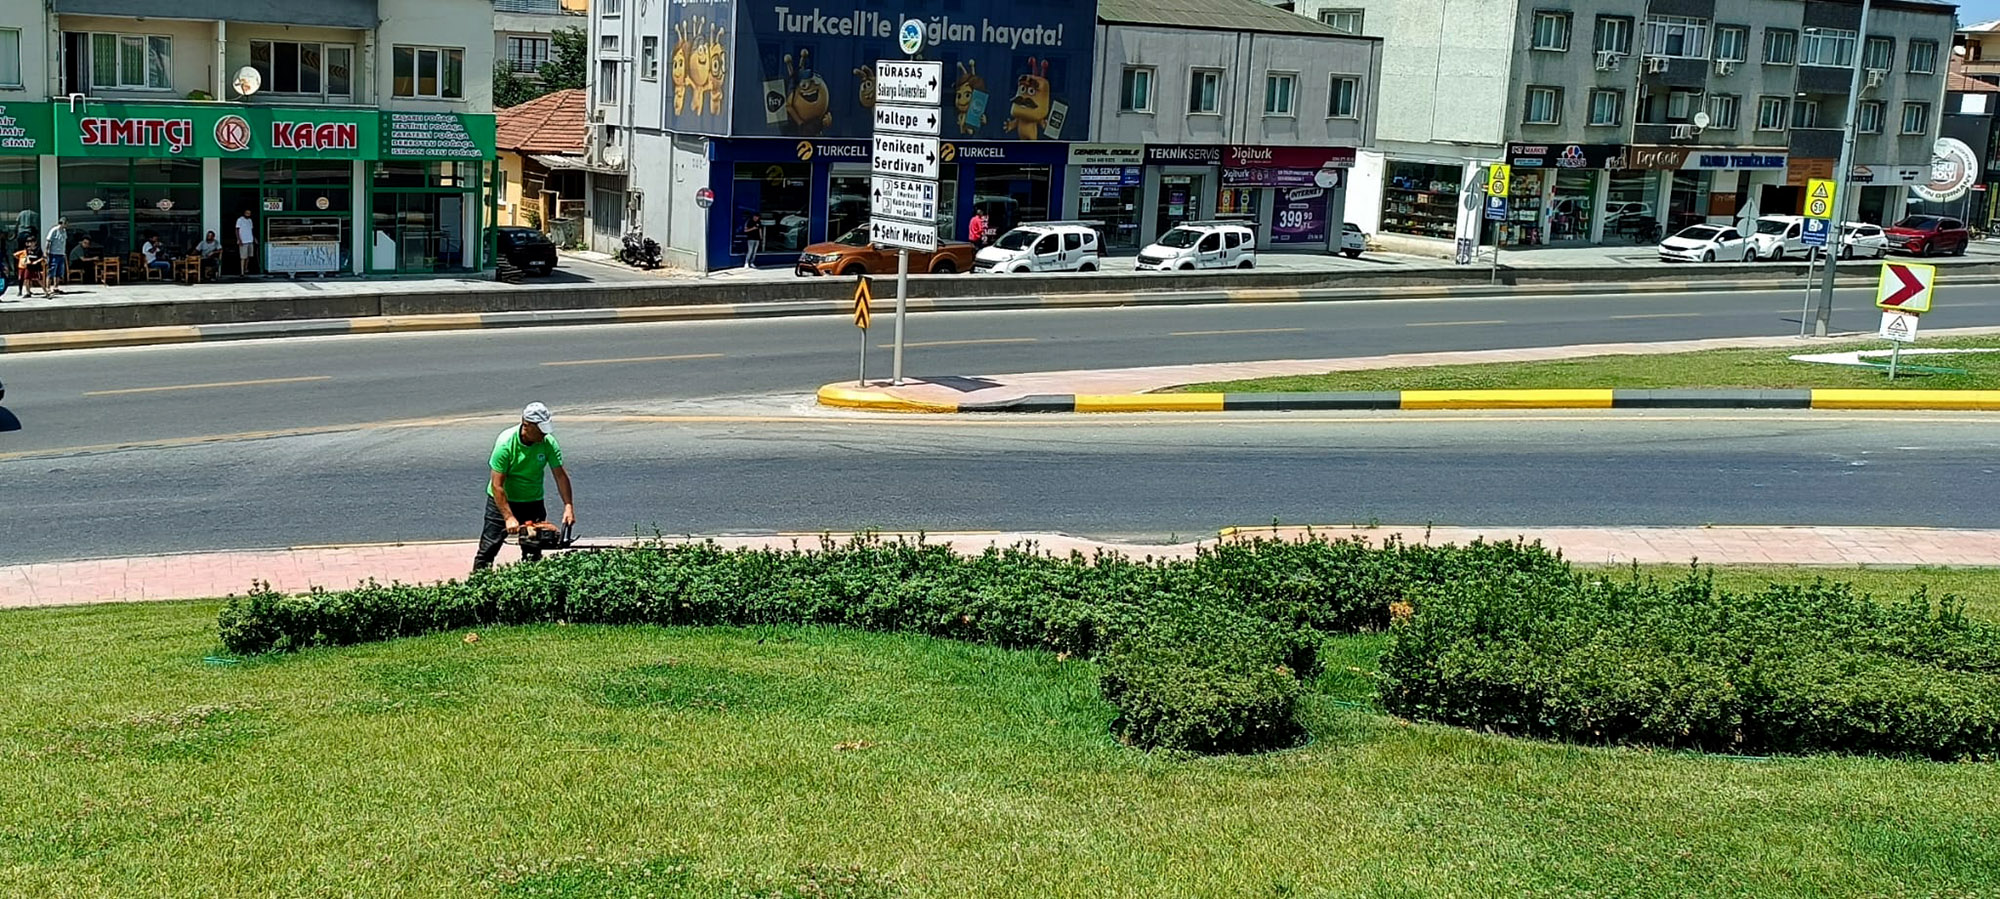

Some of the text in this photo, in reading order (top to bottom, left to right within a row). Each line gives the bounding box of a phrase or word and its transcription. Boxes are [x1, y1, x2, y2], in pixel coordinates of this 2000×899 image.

[982, 18, 1063, 50] hayata!
[878, 64, 923, 79] TÜRASAŞ
[878, 80, 927, 99] Sakarya Üniversitesi
[424, 114, 458, 123] POĞAÇA
[877, 110, 918, 128] Maltepe
[429, 123, 464, 131] POĞAÇA
[272, 122, 357, 151] KAAN
[433, 131, 469, 140] POĞAÇA
[437, 140, 475, 148] POĞAÇA
[875, 138, 924, 154] Yenikent
[448, 148, 482, 157] POĞAÇA
[816, 145, 868, 156] TURKCELL
[959, 147, 1005, 158] TURKCELL
[1150, 146, 1188, 159] TEKNİK
[874, 156, 924, 173] Serdivan
[893, 181, 922, 192] SEAH
[1813, 202, 1824, 212] 50
[881, 225, 934, 245] Şehir Merkezi
